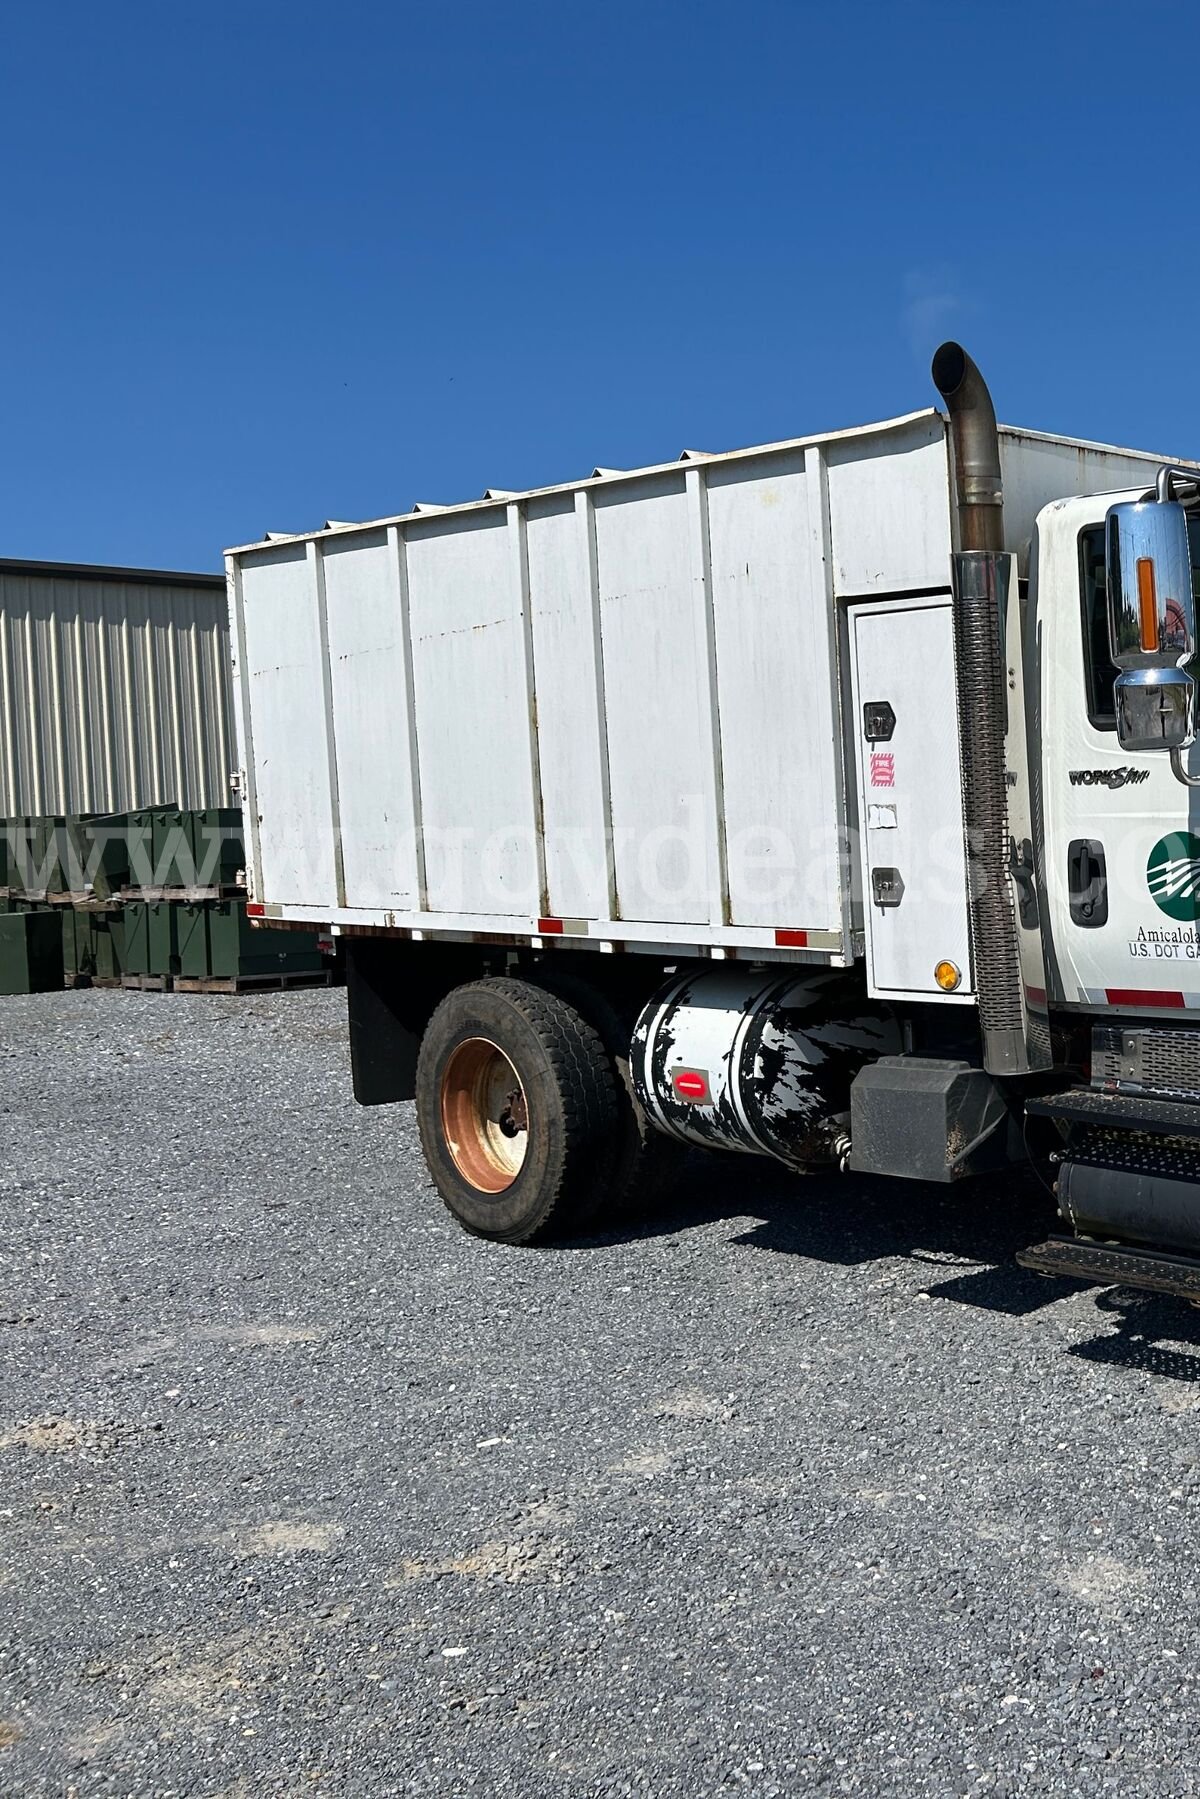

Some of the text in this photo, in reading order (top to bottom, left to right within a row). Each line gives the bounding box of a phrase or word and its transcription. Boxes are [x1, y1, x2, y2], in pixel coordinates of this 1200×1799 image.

[875, 759, 890, 767] FIRE
[1136, 925, 1200, 944] Amicalola
[1128, 942, 1151, 957] U.S.
[1155, 943, 1180, 958] DOT
